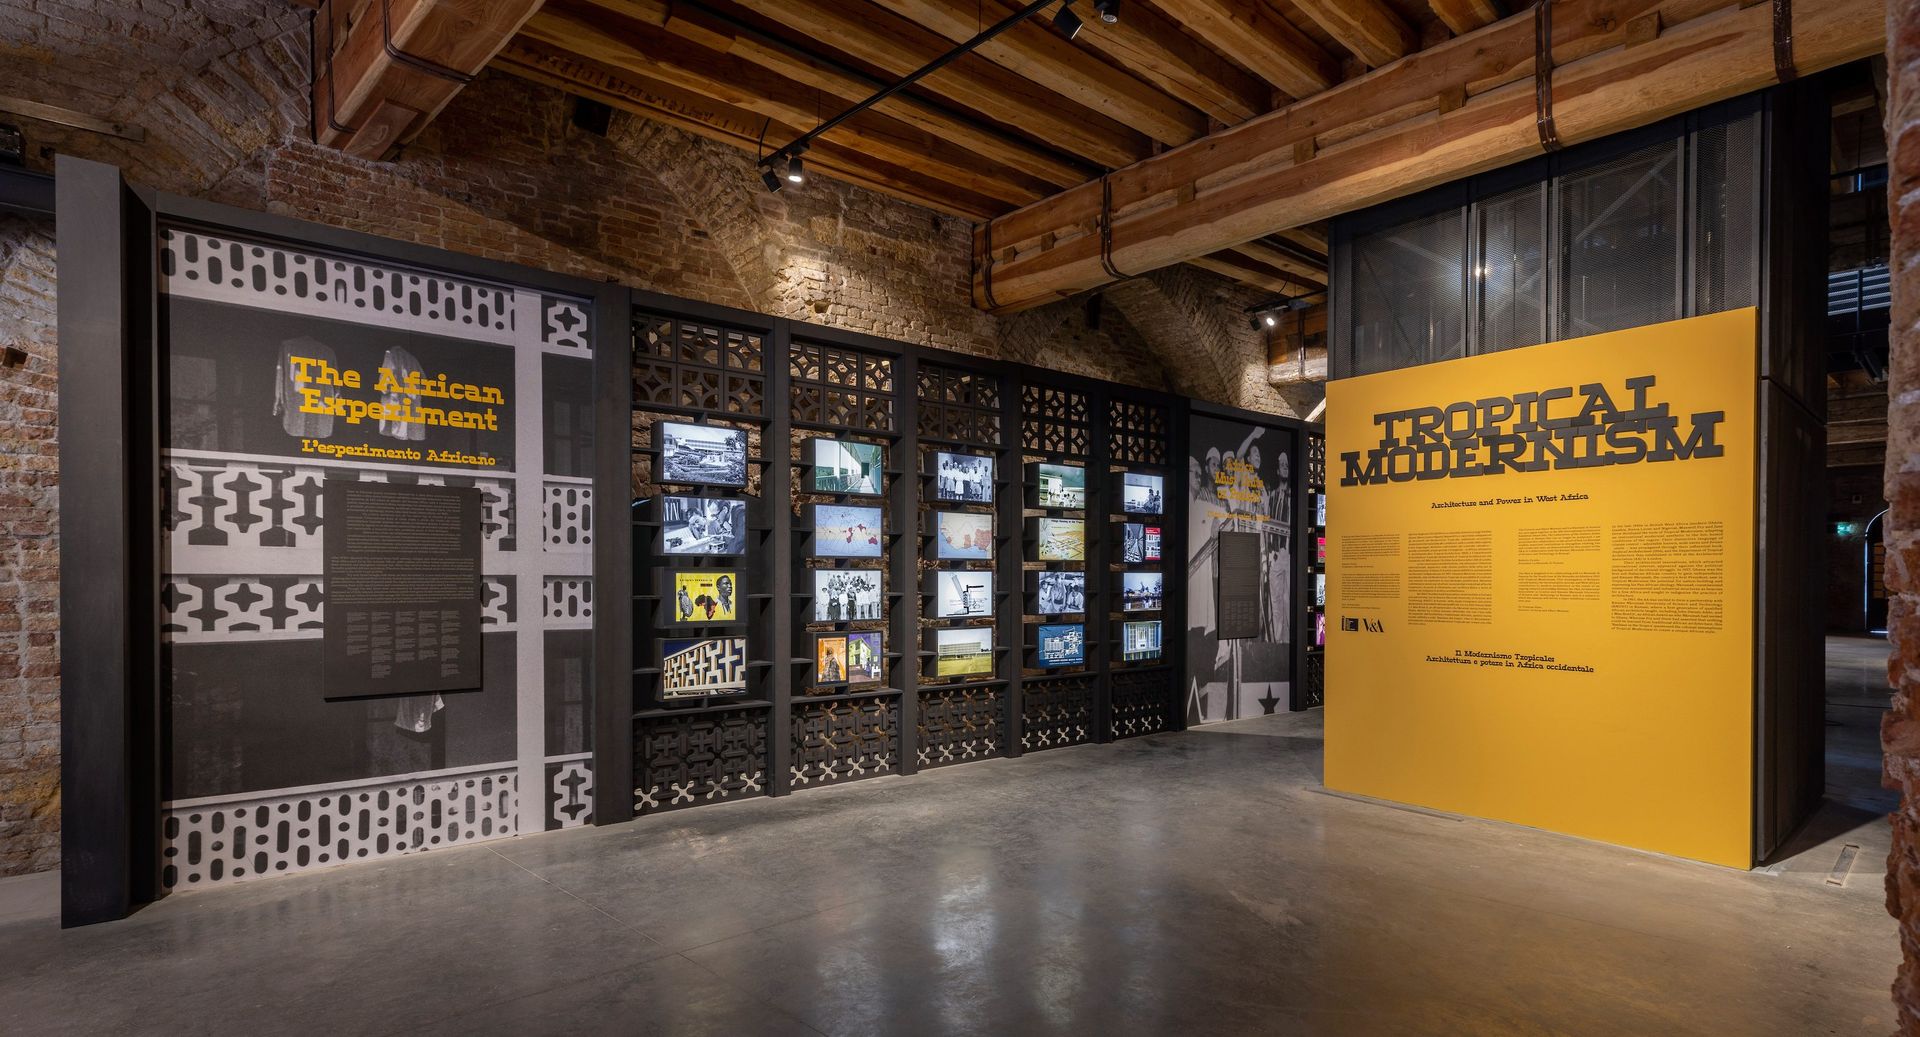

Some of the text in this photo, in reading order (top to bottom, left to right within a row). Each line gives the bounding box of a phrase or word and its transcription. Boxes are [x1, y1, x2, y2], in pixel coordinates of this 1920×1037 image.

[290, 356, 504, 405] The African
[299, 387, 498, 432] Experiment
[1373, 374, 1669, 449] TROPICAL
[301, 439, 496, 467] L'esperimento Africano
[1340, 410, 1725, 487] MODERNISM
[1431, 501, 1477, 509] Architecture
[1560, 493, 1589, 501] Africa
[1363, 617, 1384, 633] V&A
[1426, 655, 1472, 664] Architettura
[1480, 659, 1503, 667] potere
[1517, 661, 1544, 670] Africa
[1546, 663, 1594, 673] occidentale
[1464, 650, 1512, 660] Modernismo
